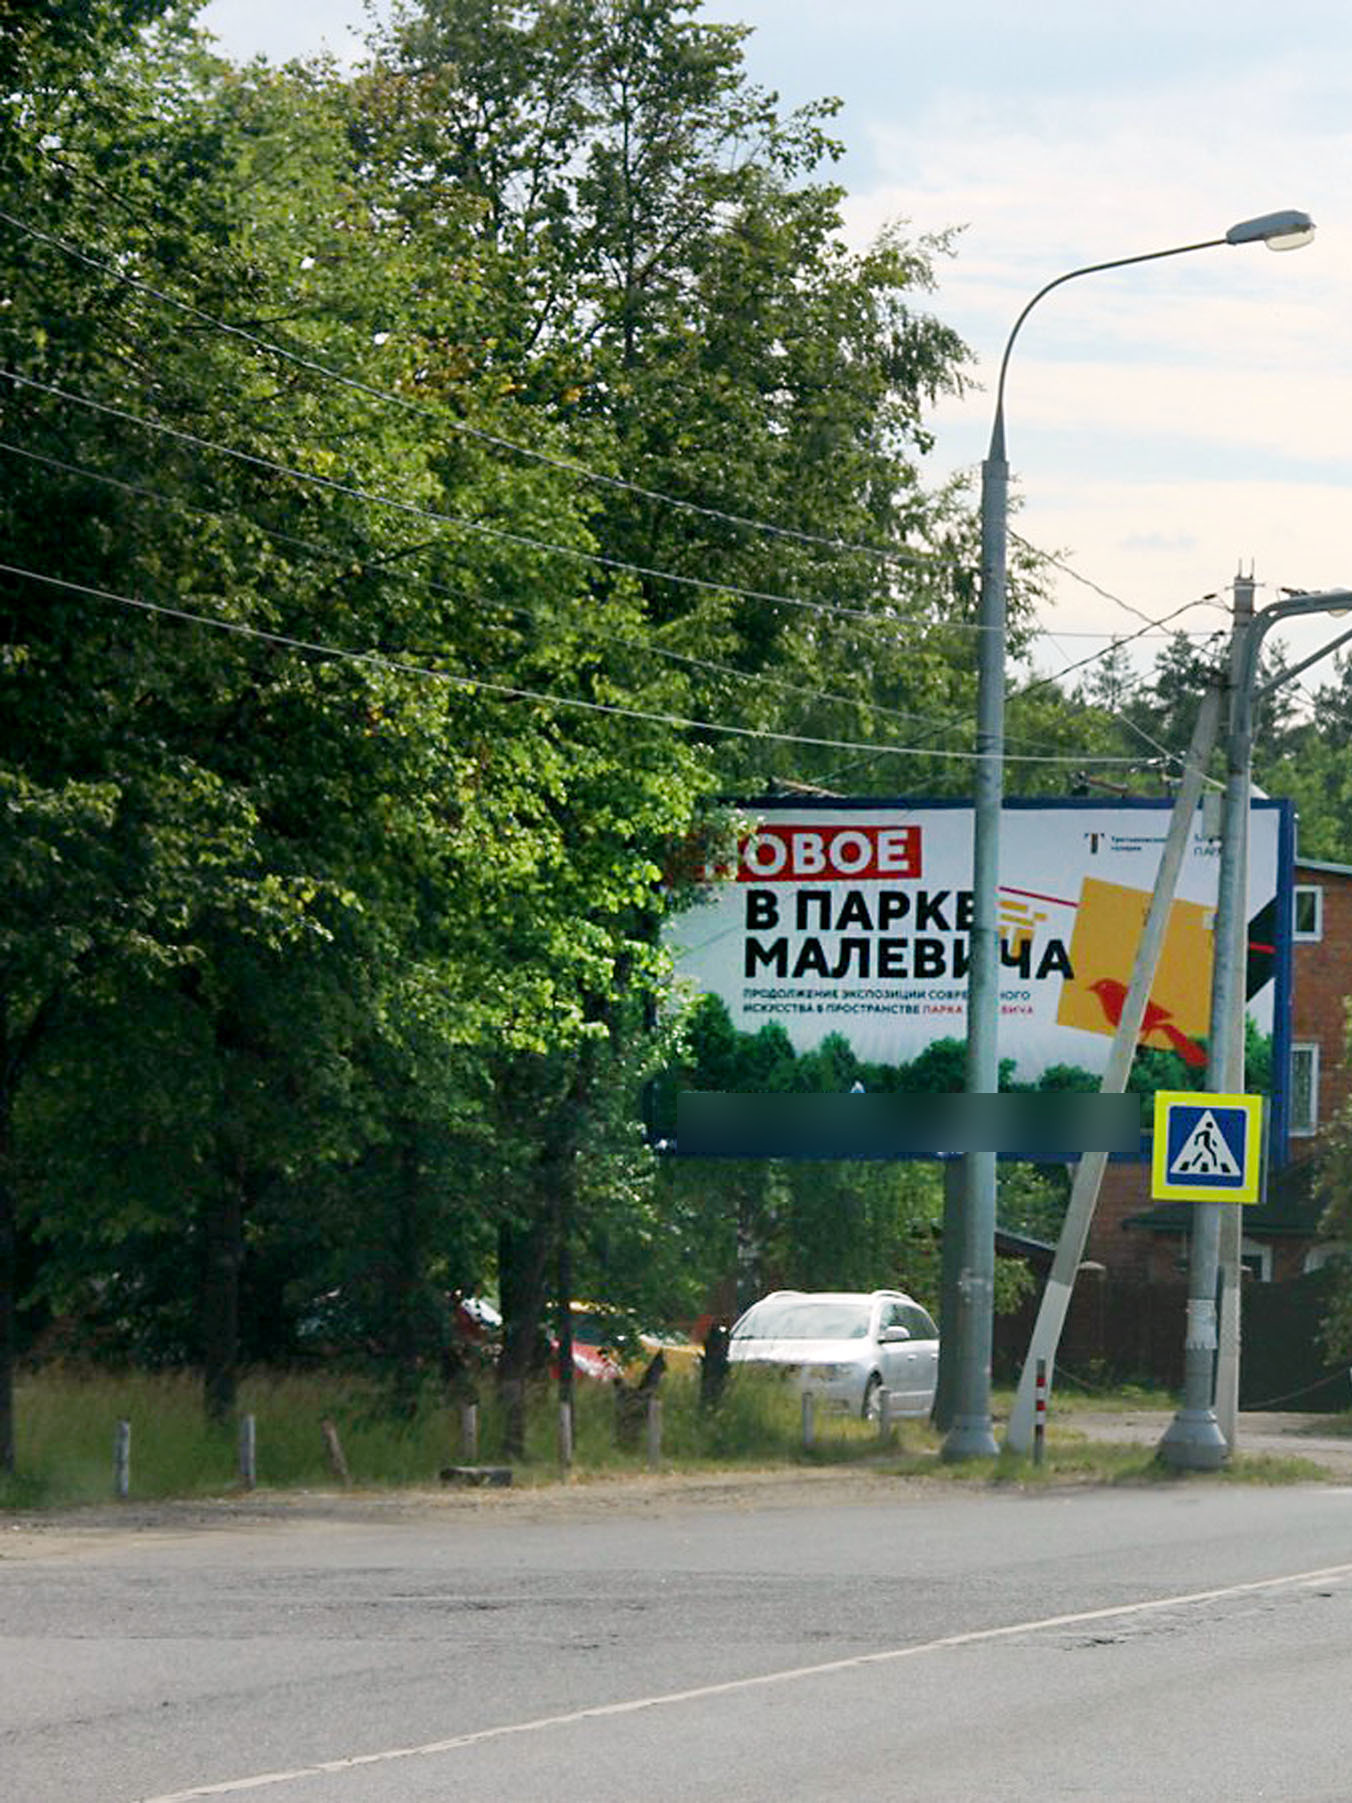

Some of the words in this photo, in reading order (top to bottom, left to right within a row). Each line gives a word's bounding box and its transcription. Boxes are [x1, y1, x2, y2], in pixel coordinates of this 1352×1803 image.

[704, 829, 910, 878] ОВОЕ
[746, 889, 780, 931] В
[743, 1003, 814, 1013] ИСКУССТВА
[826, 1003, 920, 1014] ПРОСТРАНСТВЕ
[922, 1005, 963, 1015] ПАРКА
